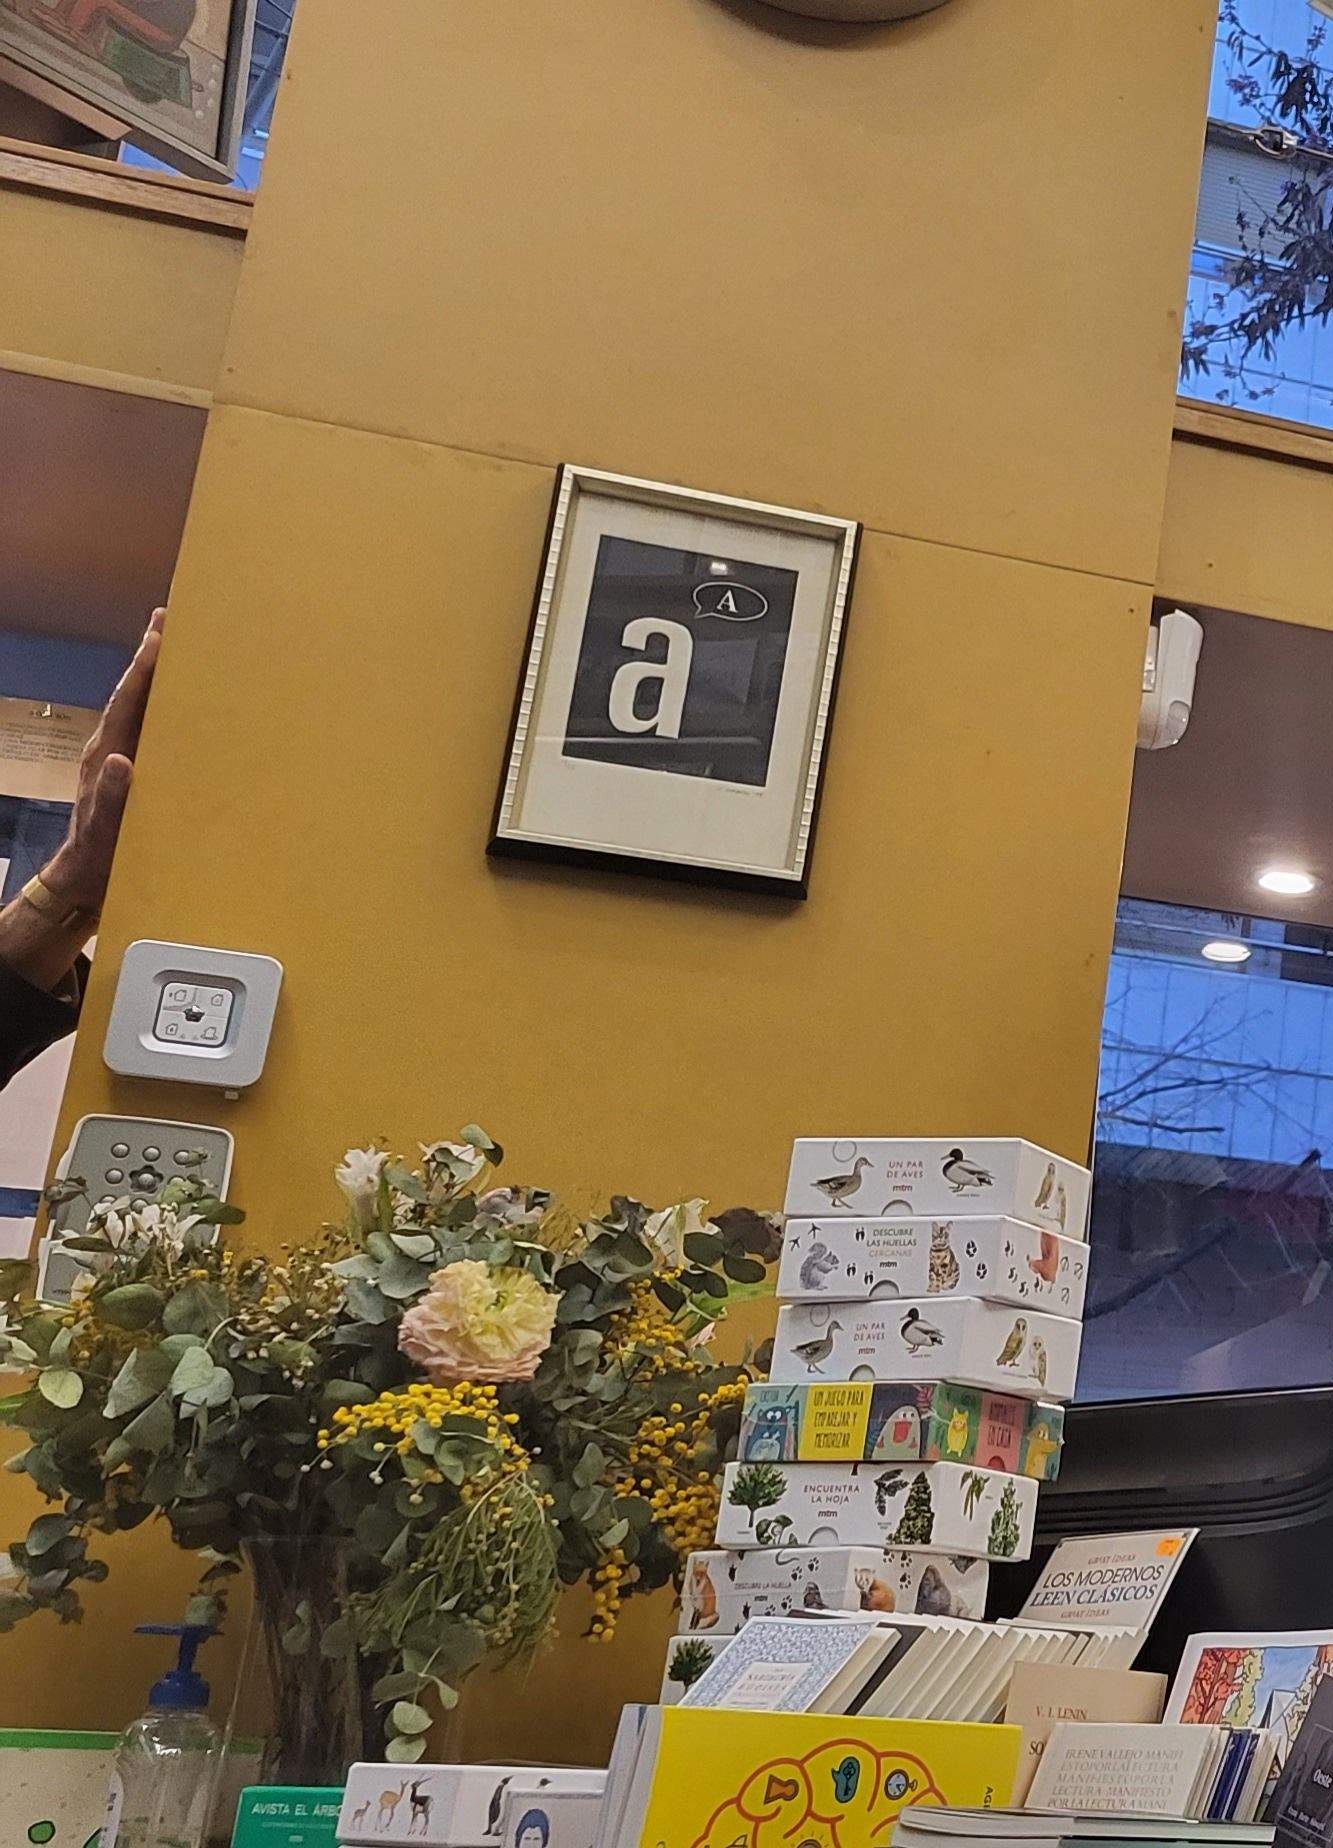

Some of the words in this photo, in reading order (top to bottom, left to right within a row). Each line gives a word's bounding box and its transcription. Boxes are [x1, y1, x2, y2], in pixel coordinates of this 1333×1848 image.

[716, 589, 739, 613] A
[608, 617, 693, 739] a
[889, 1160, 902, 1168] UN
[907, 1160, 923, 1168] PAR
[887, 1171, 898, 1179] DE
[902, 1170, 923, 1178] AVES
[873, 1228, 913, 1237] DESCUBRE
[867, 1239, 880, 1247] LAS
[883, 1239, 917, 1247] HUELLAS
[871, 1322, 886, 1330] PAR
[854, 1333, 865, 1341] DE
[867, 1332, 885, 1341] AVES
[804, 1485, 860, 1494] ENCUENTRA
[811, 1495, 822, 1503] LA
[826, 1495, 850, 1504] HOJA
[818, 1510, 838, 1518] mtm
[1043, 1572, 1074, 1589] LOS
[1074, 1565, 1165, 1587] MODERNOS
[1030, 1590, 1075, 1607] LEEN
[1077, 1584, 1158, 1605] CLÁSICOS
[1035, 1706, 1044, 1718] V.
[1056, 1707, 1088, 1720] LENIN
[1029, 1741, 1046, 1755] SO
[252, 1804, 289, 1815] AVISTA
[295, 1804, 308, 1816] EL
